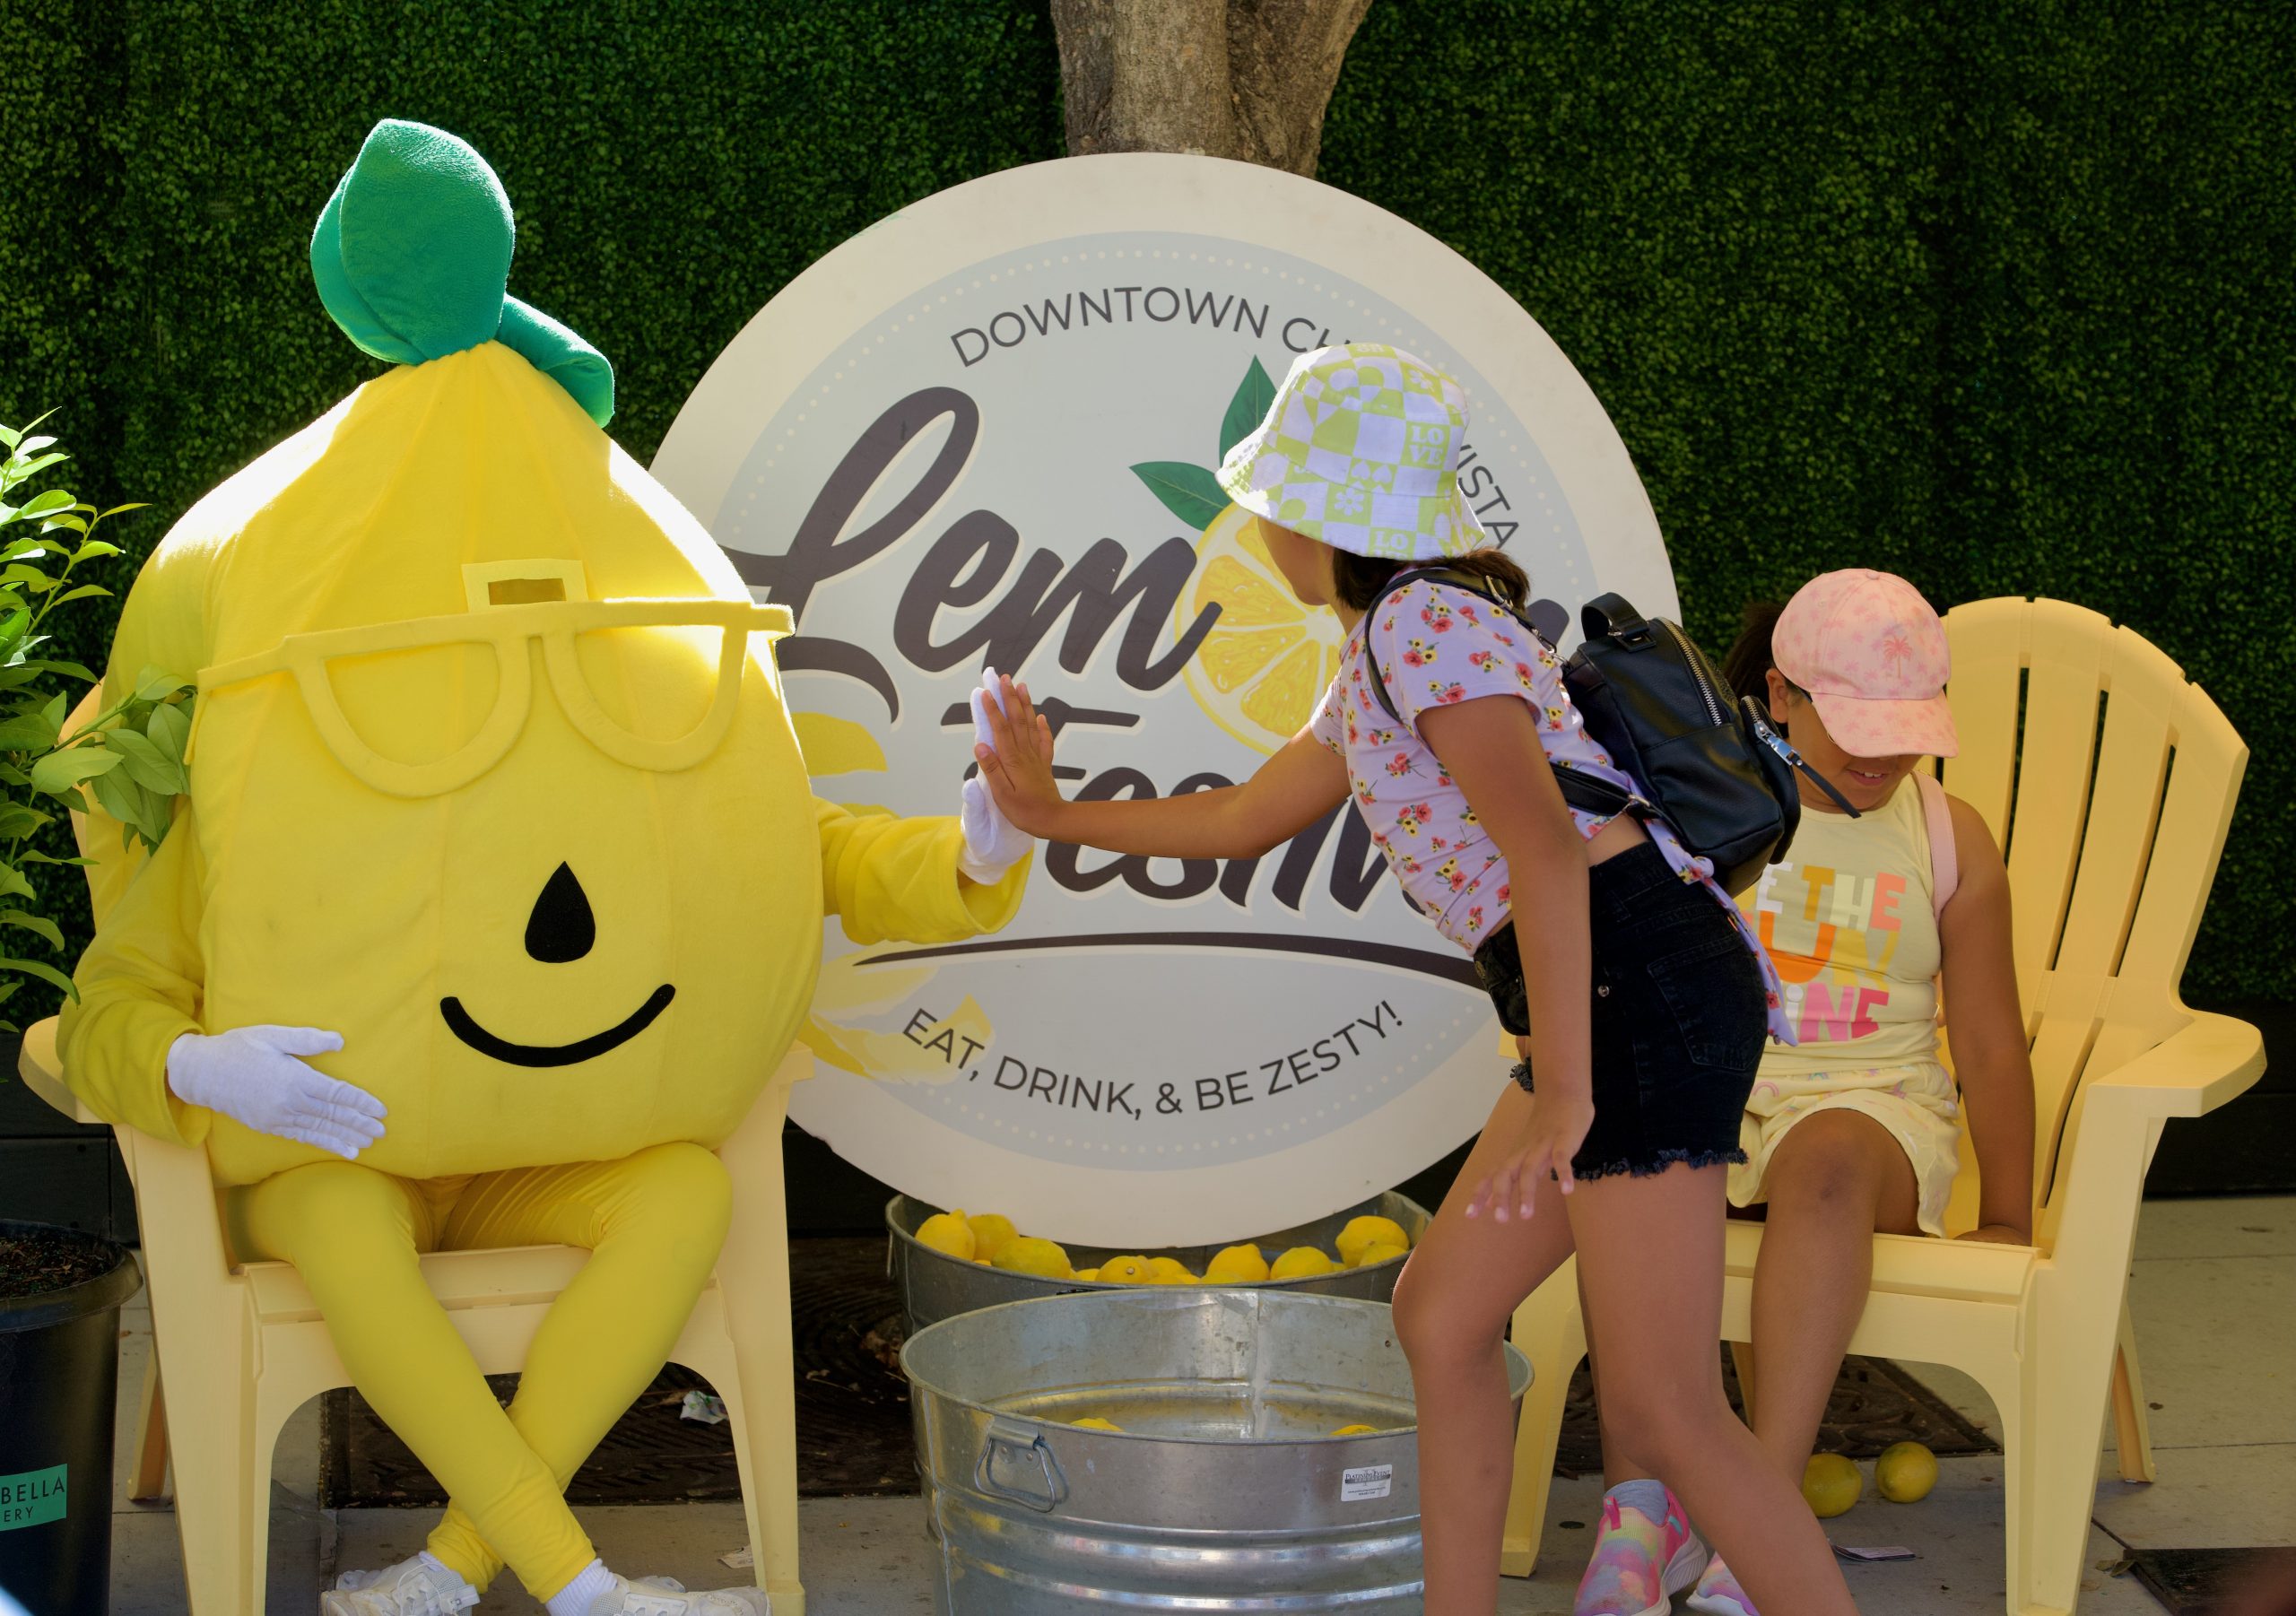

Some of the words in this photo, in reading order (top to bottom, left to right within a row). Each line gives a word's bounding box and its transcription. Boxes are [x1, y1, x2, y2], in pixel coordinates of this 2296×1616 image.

[951, 286, 1269, 367] DOWNTOWN
[1801, 864, 1907, 934] THE
[1744, 909, 1900, 994] UN
[903, 1009, 985, 1082] EAT,
[995, 1056, 1142, 1121] DRINK,
[1155, 1082, 1182, 1114] &
[1196, 1071, 1254, 1111] BE
[1260, 1000, 1403, 1096] ZESTY!
[1, 1475, 65, 1505] BELLA
[3, 1507, 34, 1523] ERY
